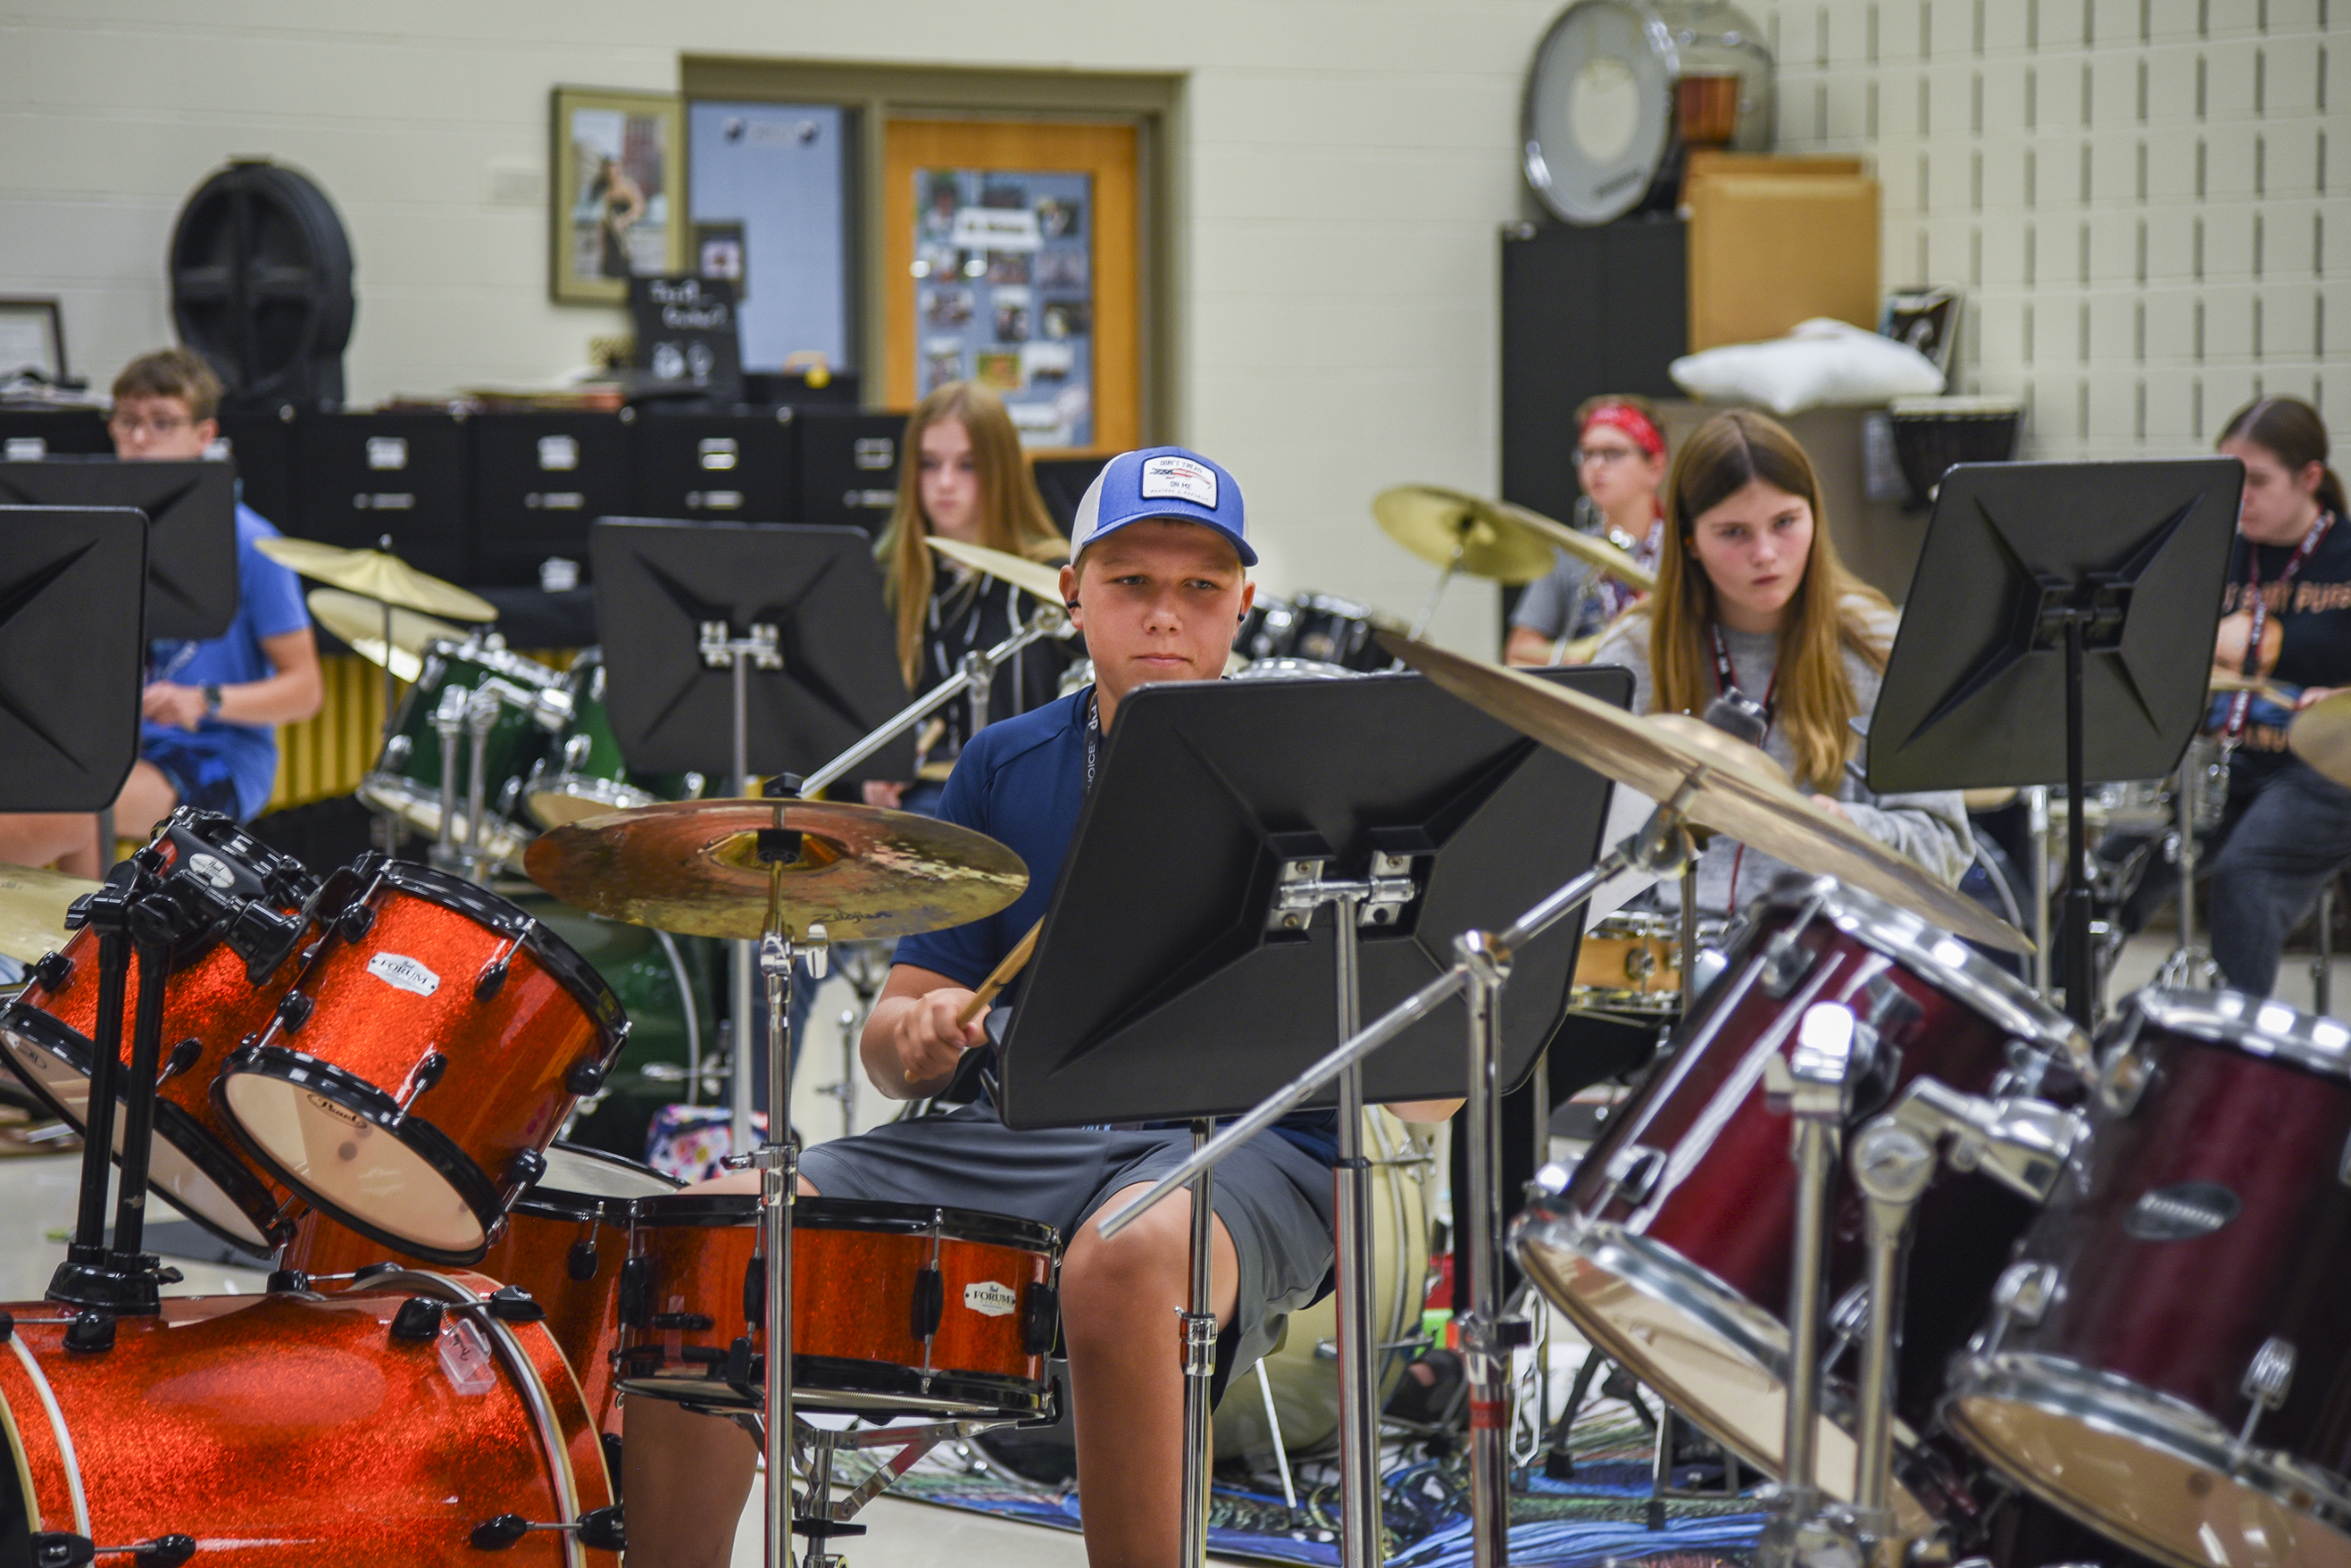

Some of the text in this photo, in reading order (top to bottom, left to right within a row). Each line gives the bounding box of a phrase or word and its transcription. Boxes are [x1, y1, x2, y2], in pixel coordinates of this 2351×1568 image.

[1182, 462, 1204, 473] TREAD
[380, 960, 429, 985] FORUM
[973, 1290, 1011, 1305] FORUM
